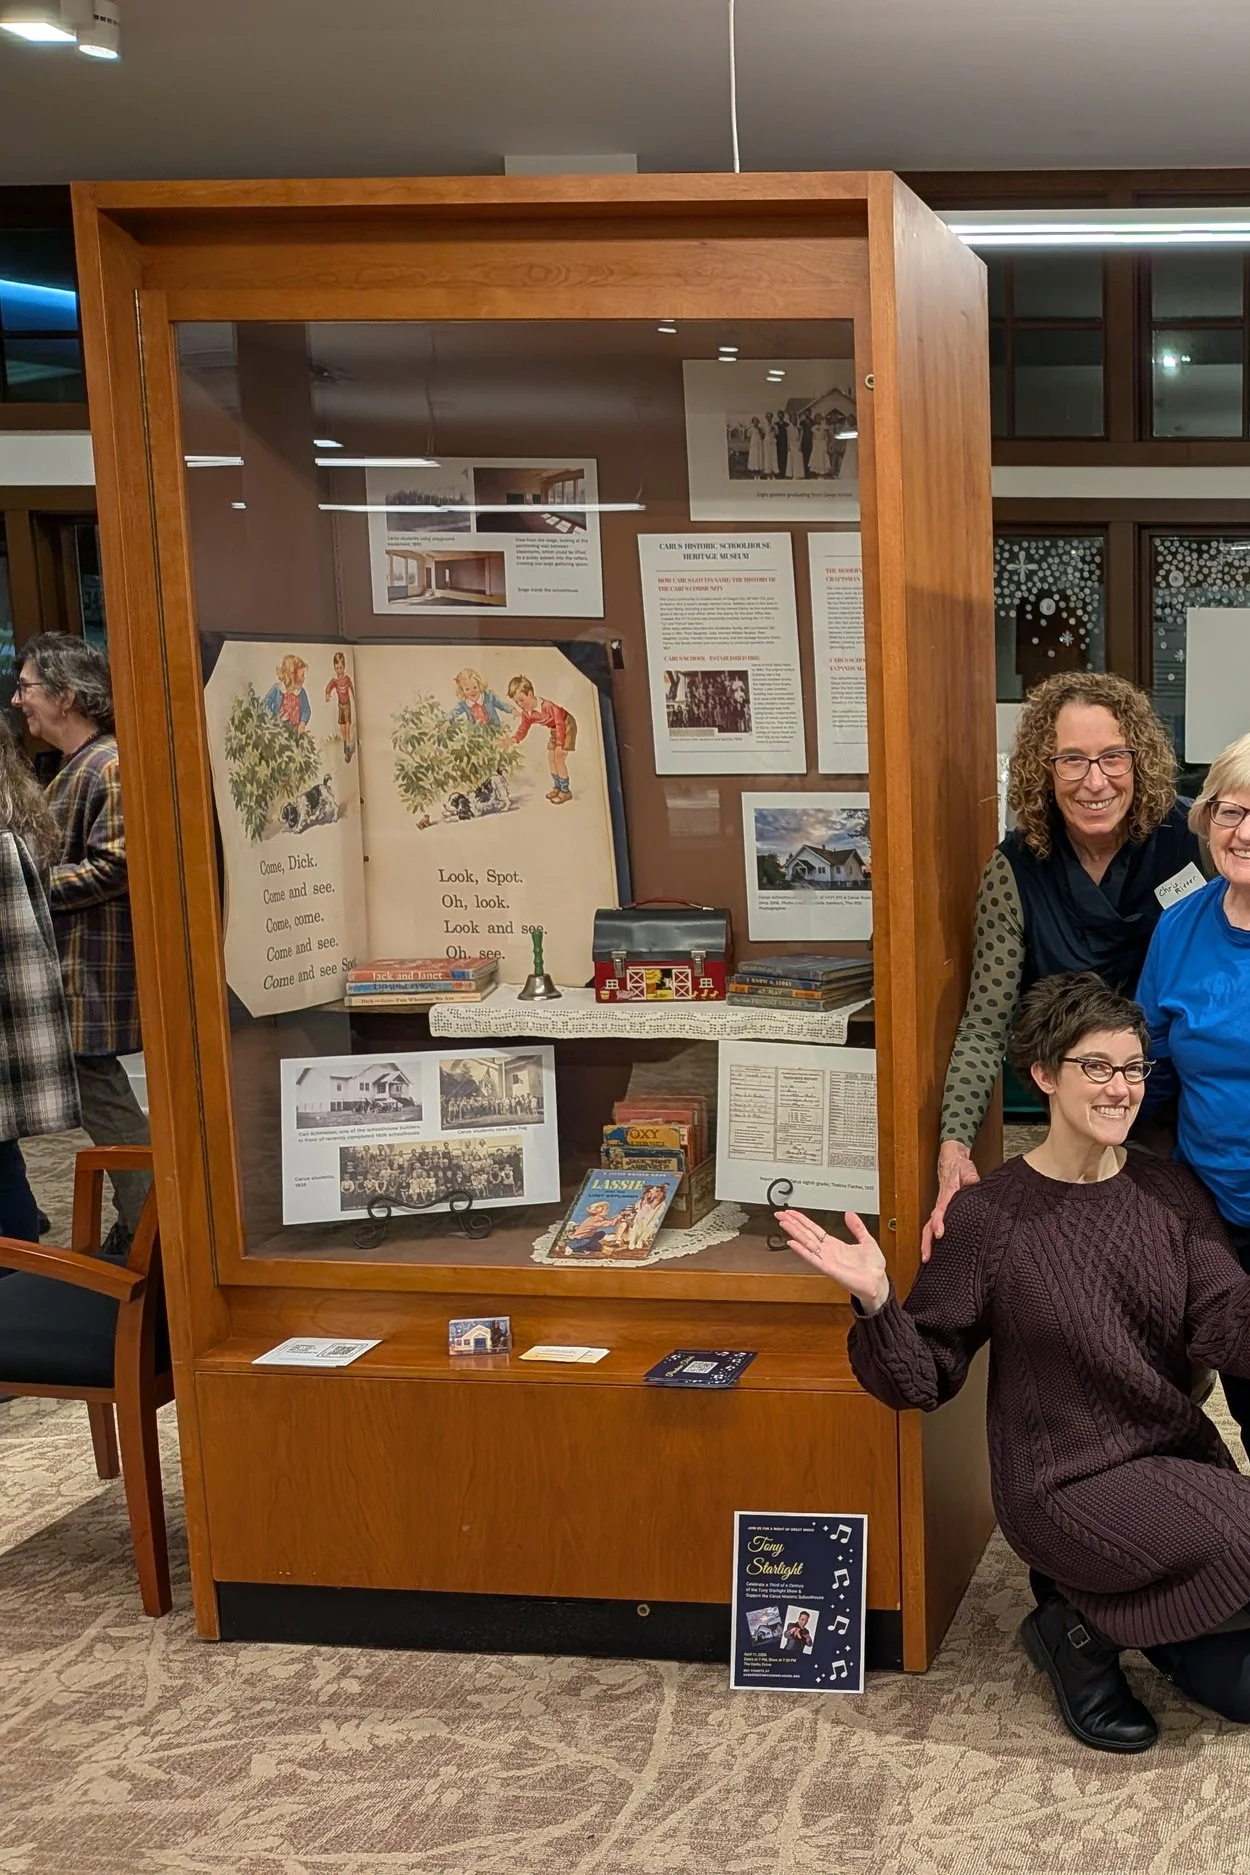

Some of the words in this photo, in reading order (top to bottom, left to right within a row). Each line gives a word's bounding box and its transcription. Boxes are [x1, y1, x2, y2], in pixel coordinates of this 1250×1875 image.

[260, 860, 285, 876] Come,
[288, 853, 318, 870] Dick.
[438, 869, 479, 885] Look,
[486, 869, 523, 886] Spot.
[263, 889, 286, 905] Come
[289, 882, 307, 899] and
[313, 883, 335, 895] see.
[1159, 883, 1178, 896] Chris
[442, 894, 468, 911] Oh,
[475, 894, 510, 908] look.
[266, 918, 292, 933] Come,
[294, 912, 324, 926] come.
[444, 920, 480, 934] Look
[487, 921, 514, 934] and
[521, 925, 548, 934] see.
[266, 947, 292, 962] Come
[296, 937, 312, 955] and
[317, 937, 339, 950] see.
[479, 950, 505, 960] see.
[263, 975, 295, 990] Come
[298, 964, 315, 982] and
[320, 964, 337, 977] see
[372, 972, 394, 980] Jack
[398, 972, 414, 980] and
[417, 971, 443, 980] Janet
[592, 1179, 645, 1190] LASSIE
[747, 1536, 785, 1557] Tony
[746, 1557, 804, 1580] Starlight
